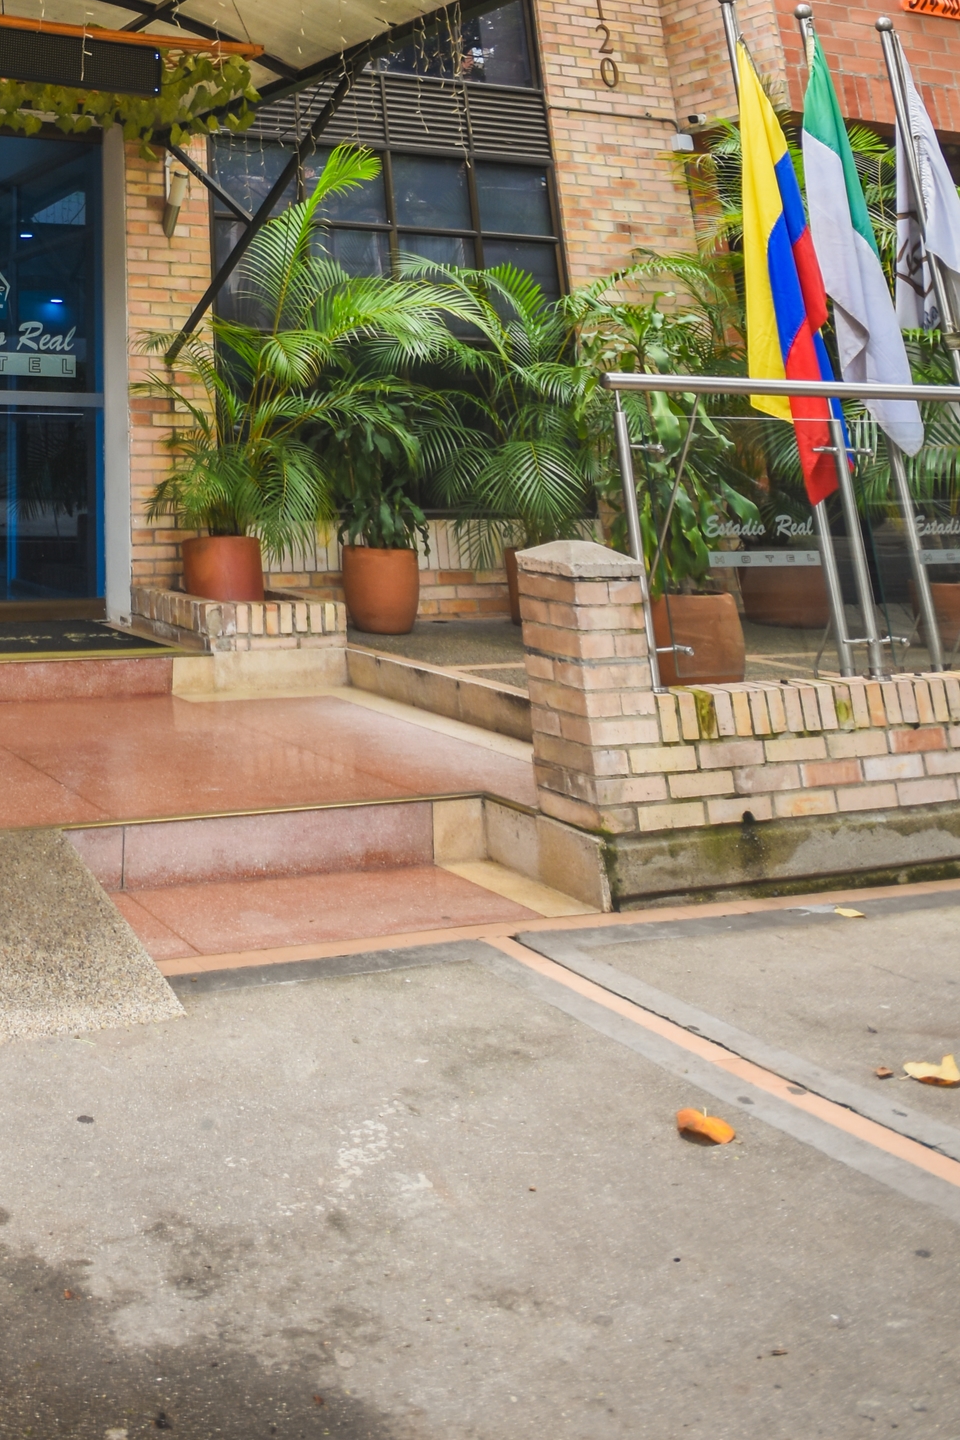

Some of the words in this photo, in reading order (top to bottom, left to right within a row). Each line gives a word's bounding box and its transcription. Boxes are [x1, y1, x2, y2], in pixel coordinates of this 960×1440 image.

[16, 321, 77, 352] Real
[706, 514, 767, 538] Estadio
[774, 514, 814, 537] Real
[914, 514, 960, 537] Estadi
[715, 554, 816, 565] HOTEL
